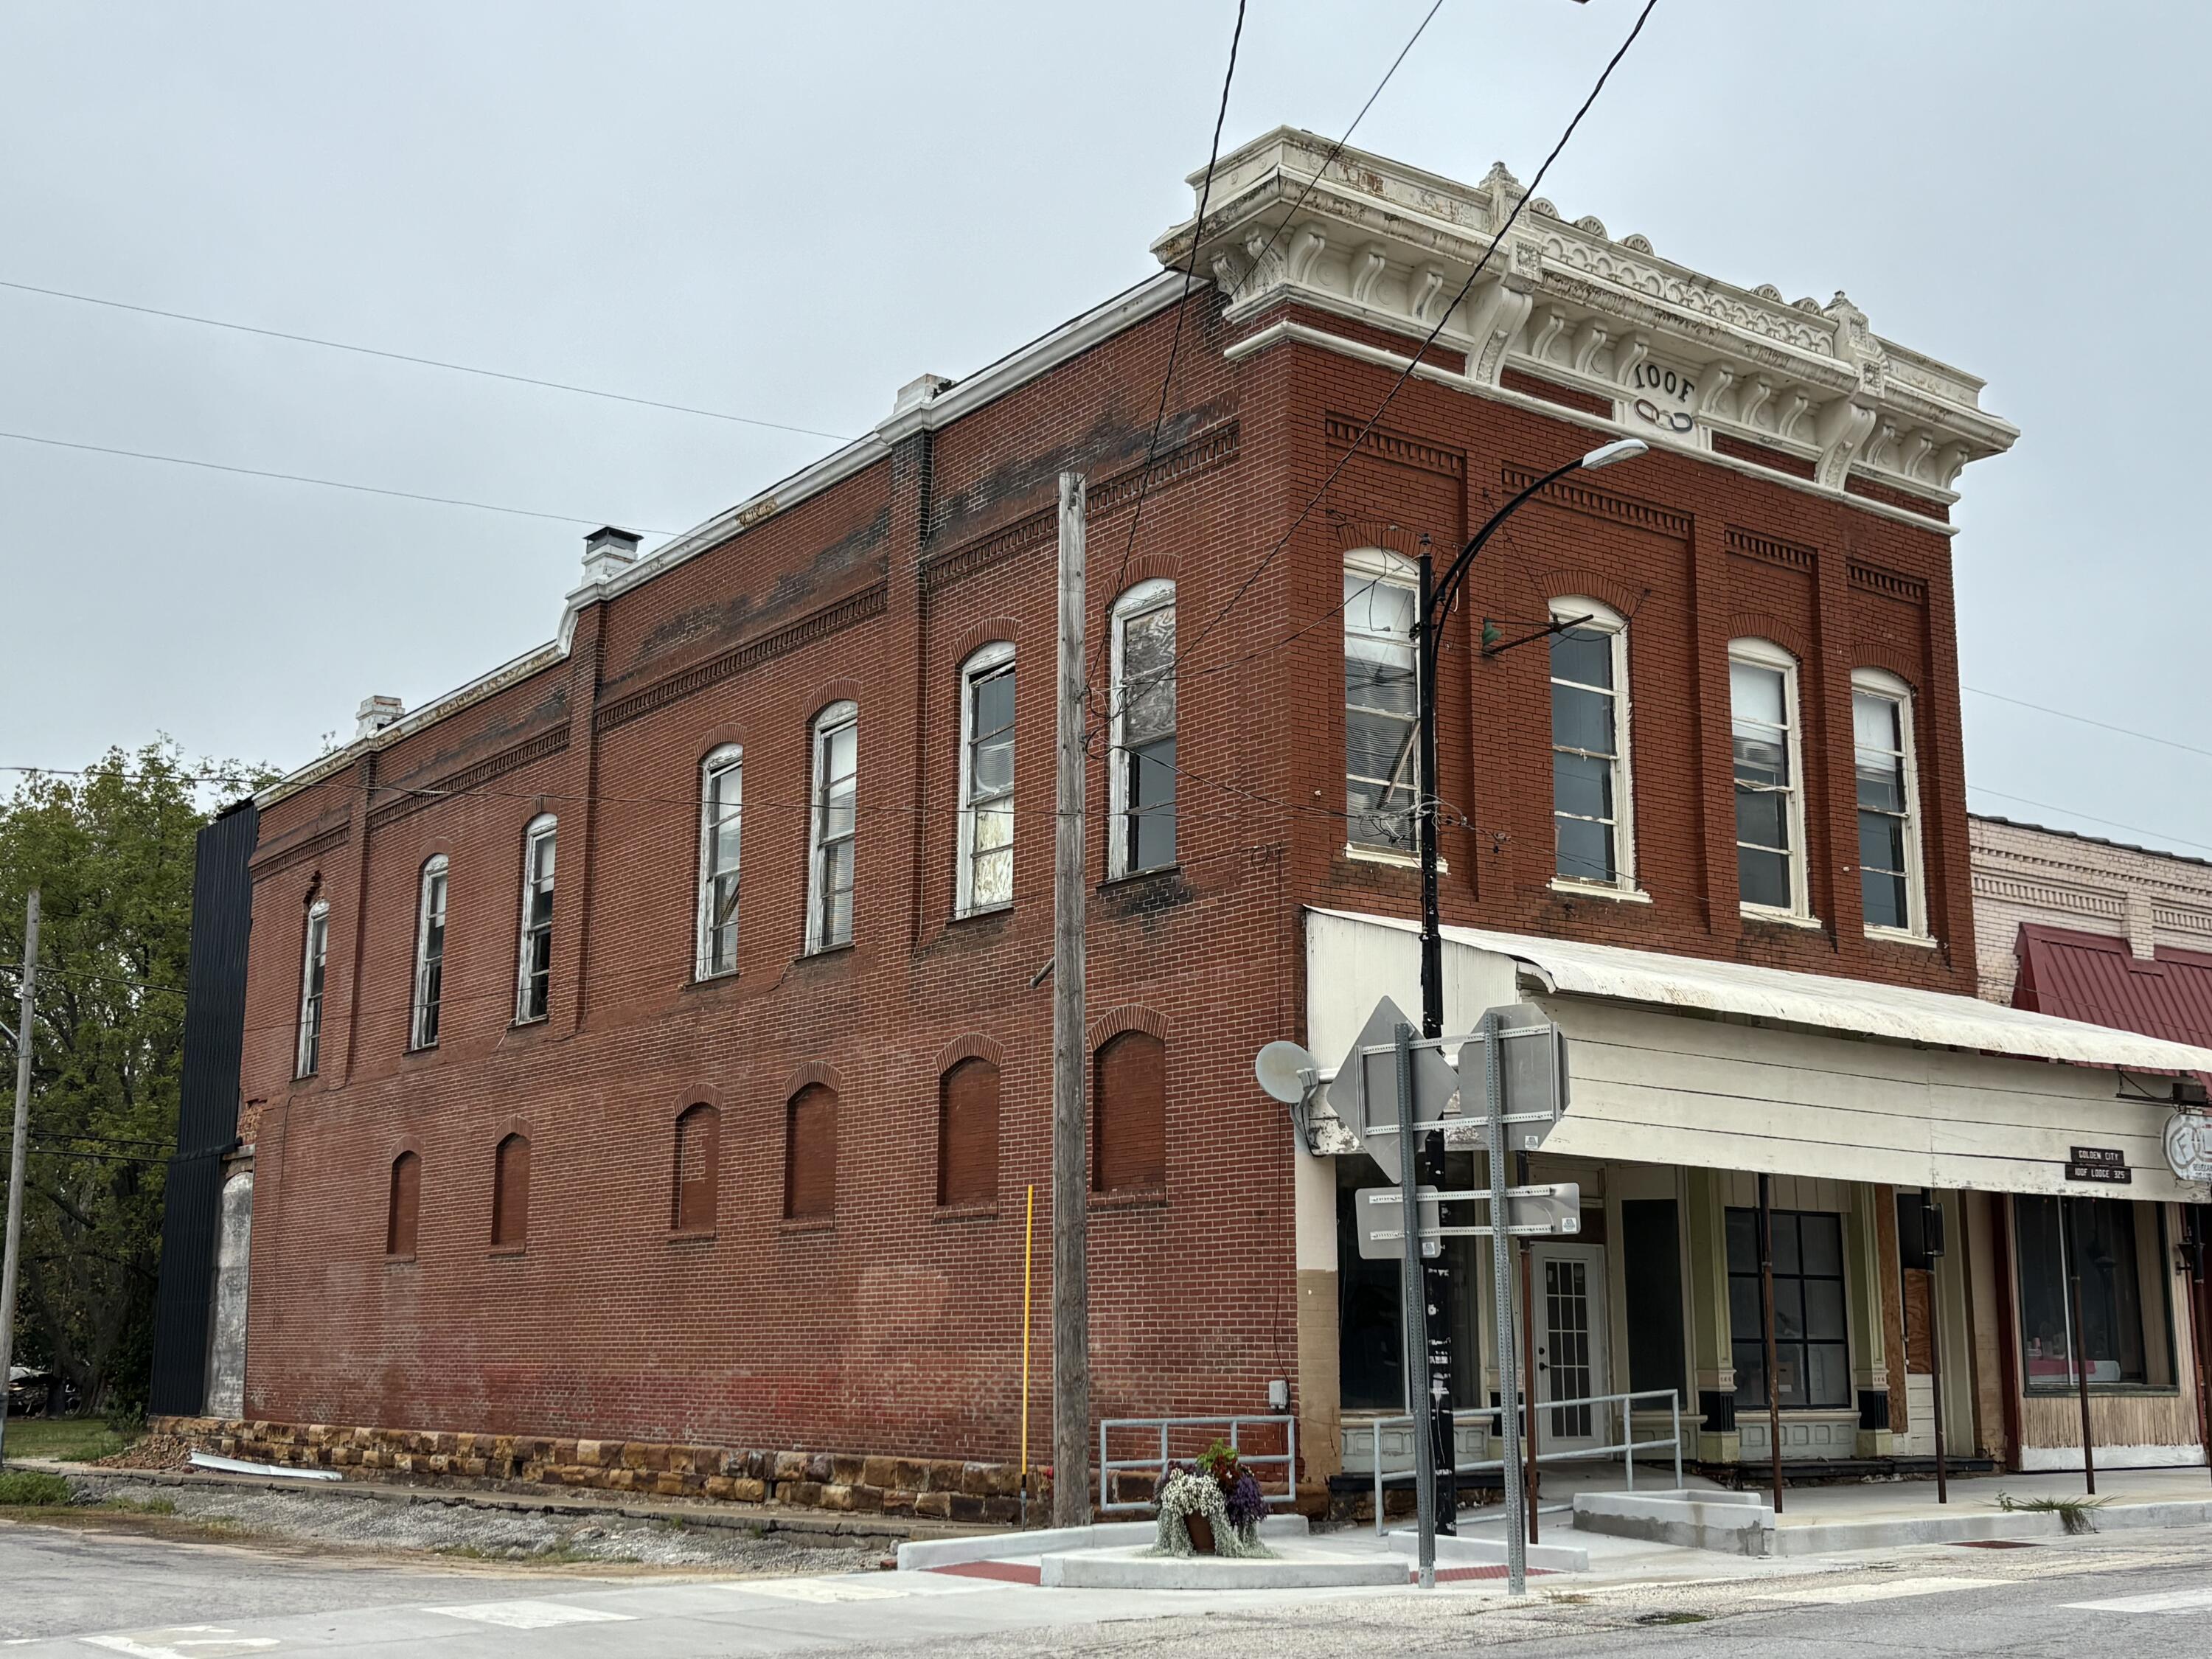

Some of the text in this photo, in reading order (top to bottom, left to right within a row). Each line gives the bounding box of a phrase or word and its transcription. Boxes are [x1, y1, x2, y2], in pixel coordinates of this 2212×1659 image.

[1635, 364, 1695, 402] IOOF
[2079, 1150, 2118, 1161] GOLDEN CITY
[2075, 1167, 2125, 1179] IOOF LODGE 325
